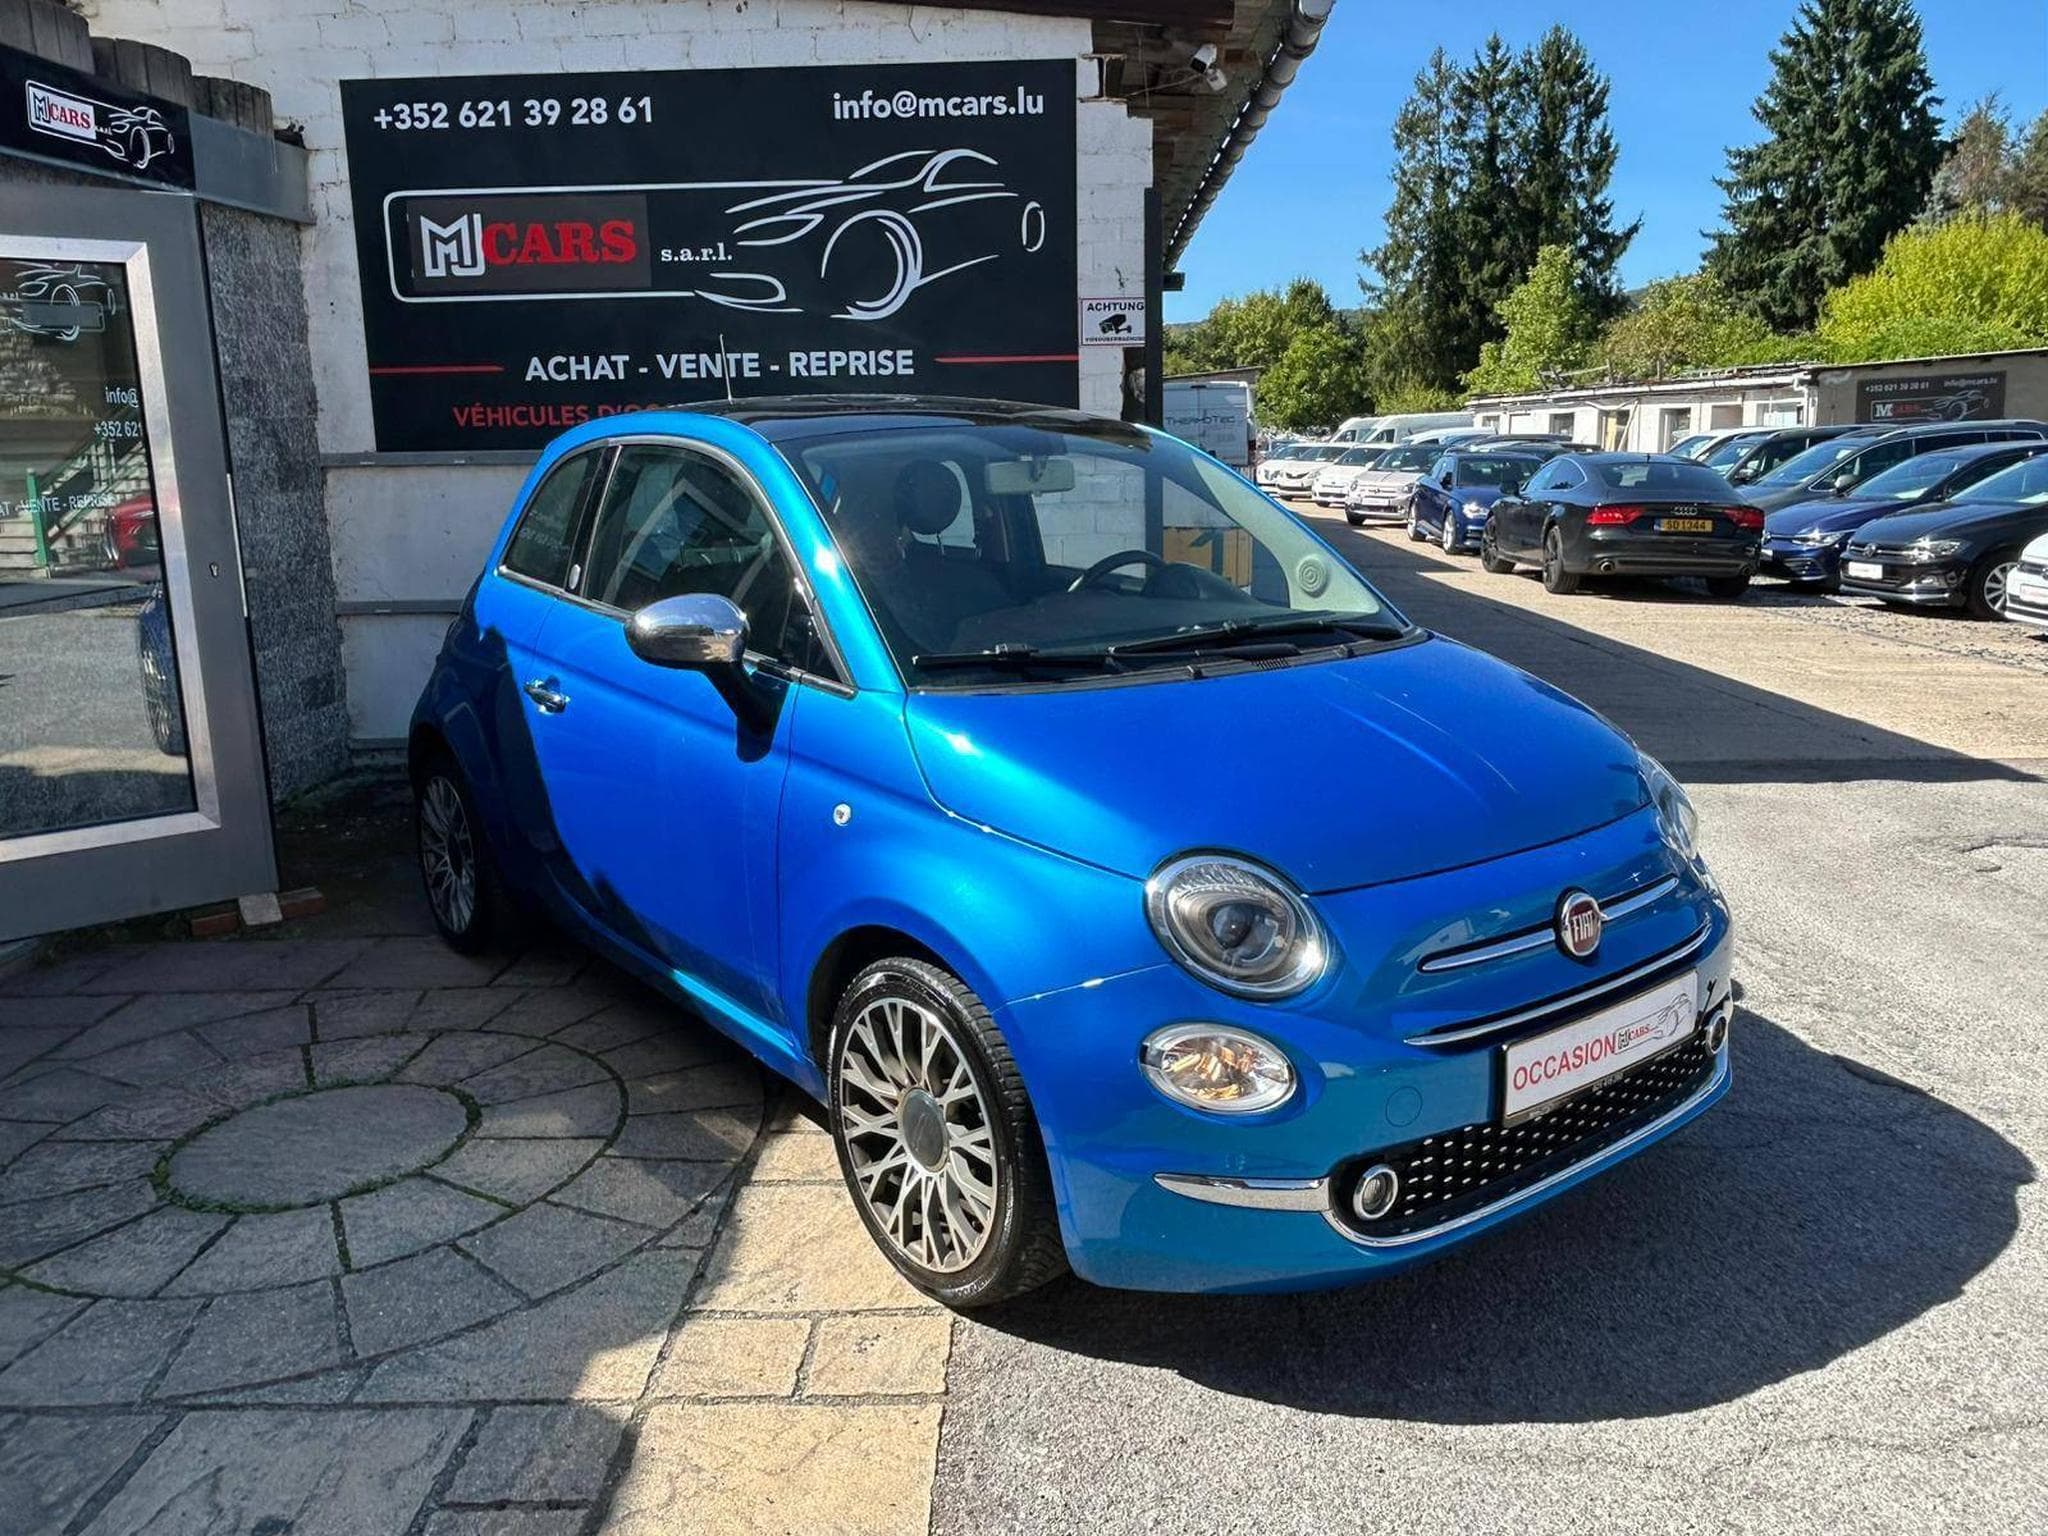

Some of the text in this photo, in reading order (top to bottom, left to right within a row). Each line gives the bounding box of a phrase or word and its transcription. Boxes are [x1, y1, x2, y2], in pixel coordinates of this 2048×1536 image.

[374, 96, 653, 130] +352 621 39 28 61
[833, 86, 1044, 120] info@mcars.lu
[660, 243, 733, 262] s.a.r.l.
[1087, 302, 1145, 312] ACHTUNG
[525, 354, 629, 381] ACHAT
[656, 352, 761, 379] VENTE
[789, 349, 915, 377] REPRISE
[94, 421, 123, 437] +352
[452, 402, 591, 427] VÉHICULES
[1572, 909, 1595, 942] FIAT
[1513, 1033, 1615, 1091] OCCASION
